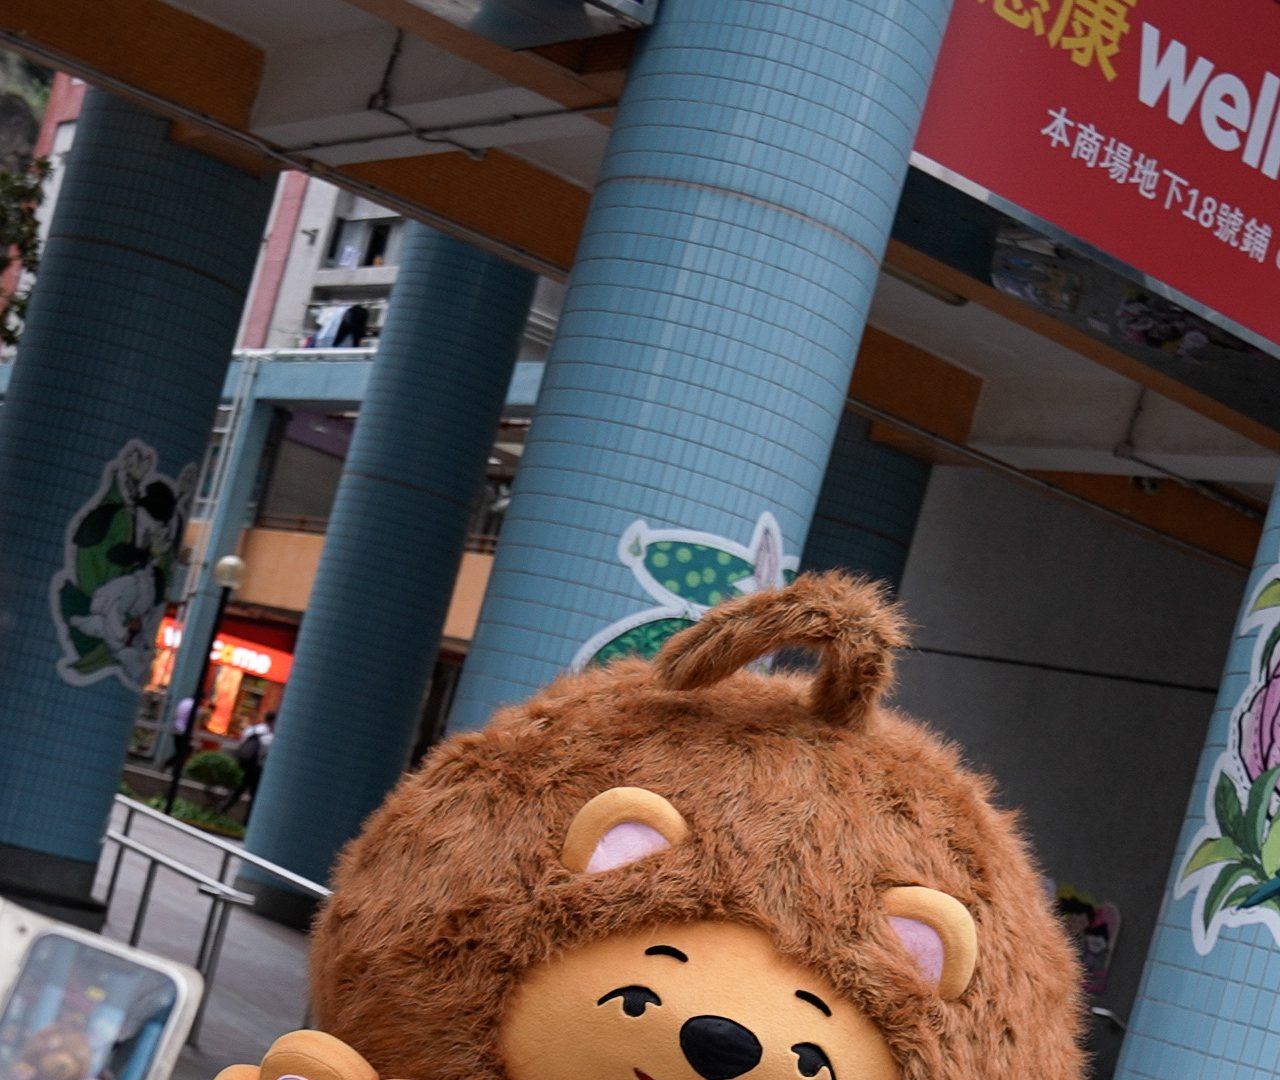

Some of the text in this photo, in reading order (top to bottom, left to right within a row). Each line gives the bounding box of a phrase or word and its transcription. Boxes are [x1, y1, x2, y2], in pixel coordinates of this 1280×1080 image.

[978, 0, 1136, 82] 康
[1040, 107, 1272, 263] 本商場地下18號鋪
